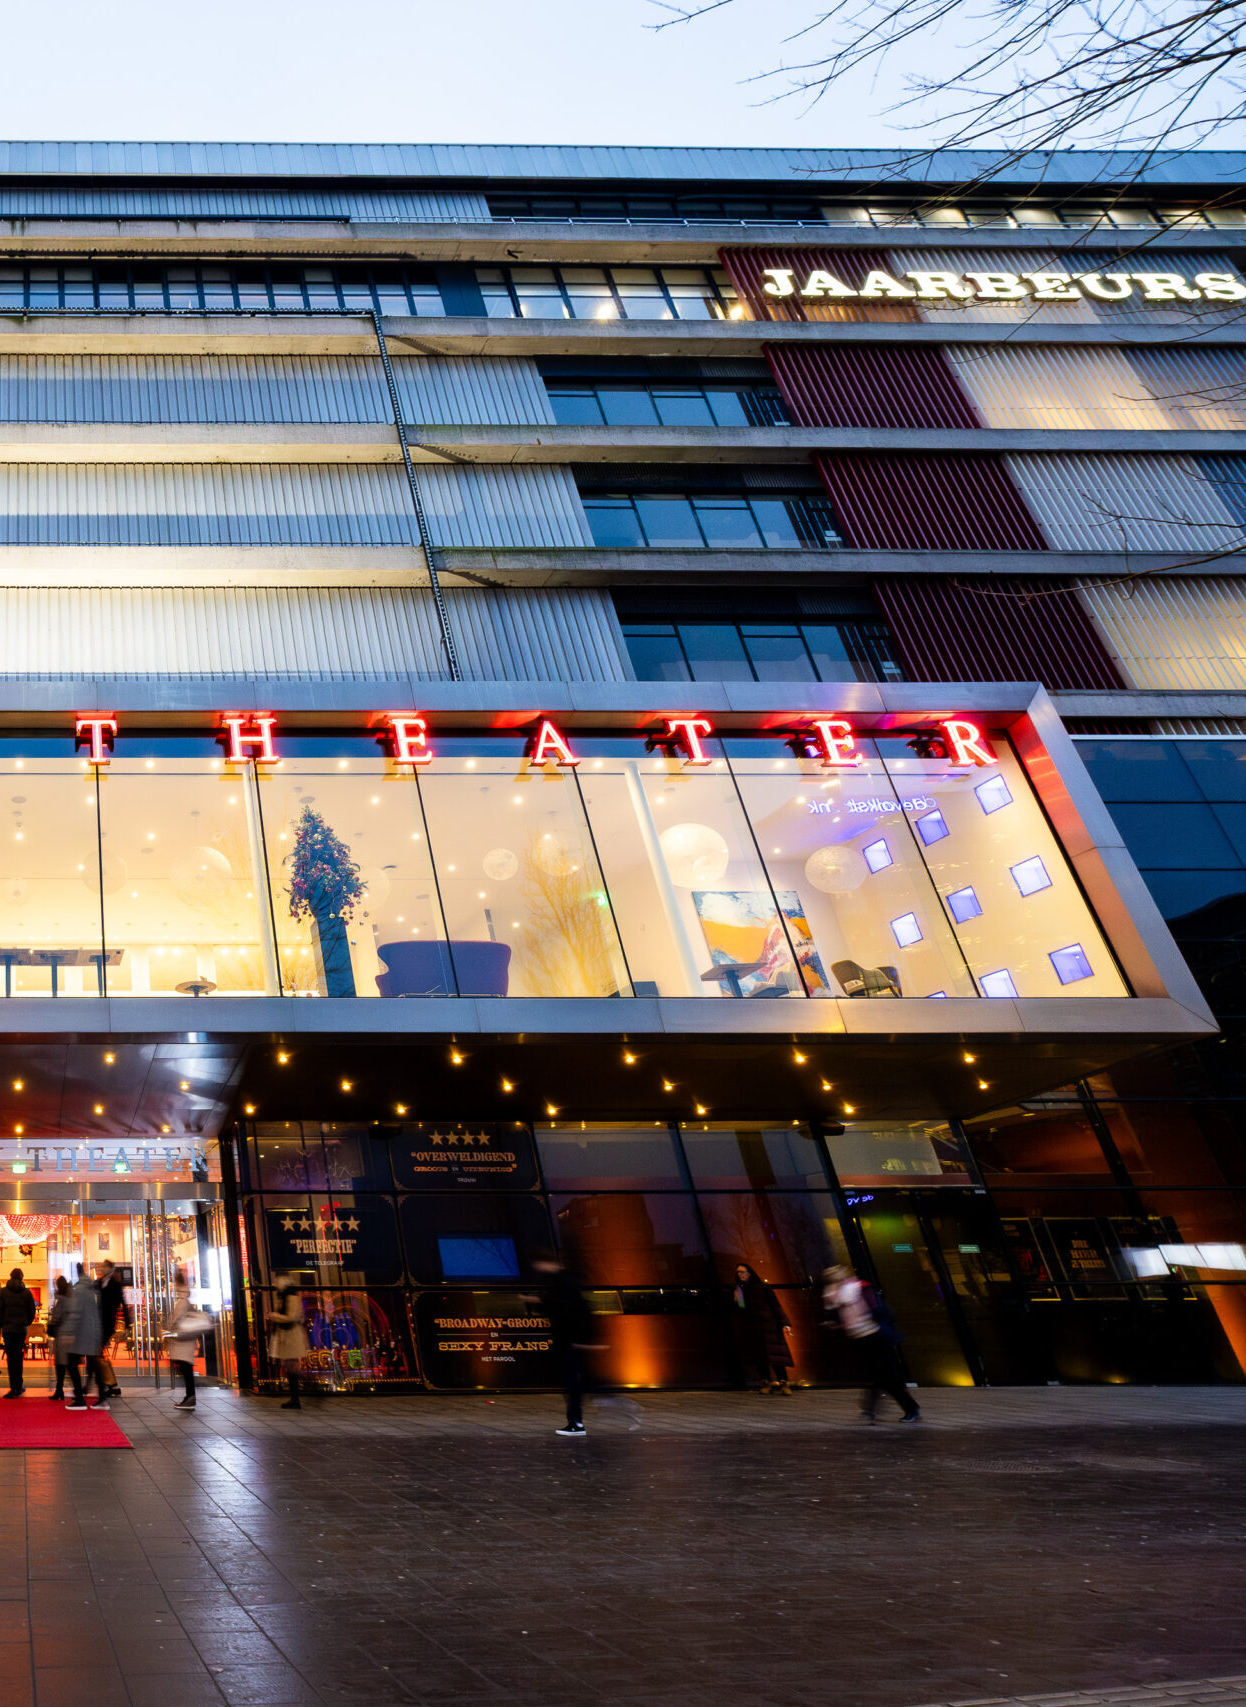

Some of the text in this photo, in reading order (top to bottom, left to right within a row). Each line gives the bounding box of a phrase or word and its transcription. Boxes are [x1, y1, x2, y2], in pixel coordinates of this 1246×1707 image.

[763, 269, 1246, 302] JAARBEURS
[74, 718, 999, 768] THEATER
[26, 1146, 211, 1172] THEATER
[438, 1341, 485, 1351] SEXY
